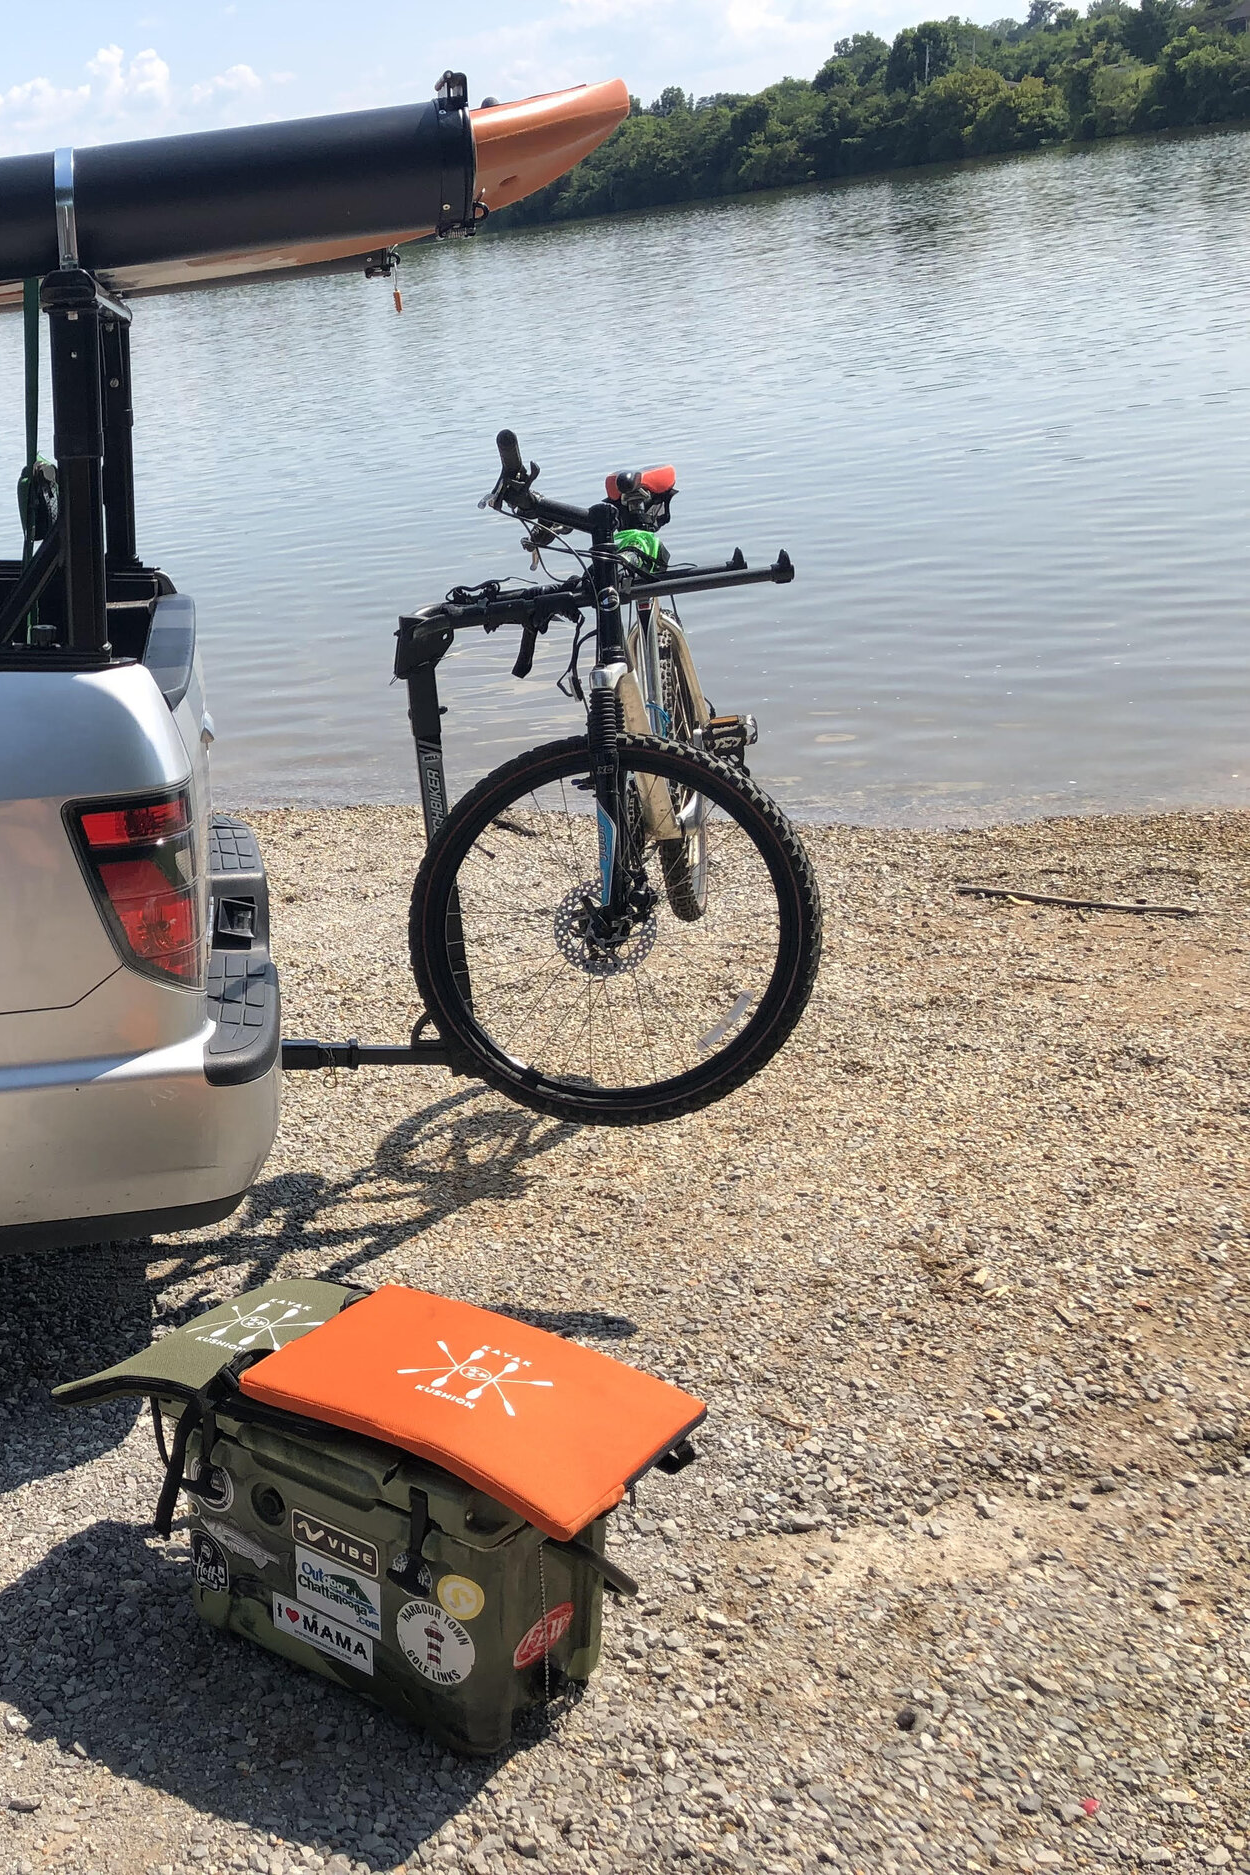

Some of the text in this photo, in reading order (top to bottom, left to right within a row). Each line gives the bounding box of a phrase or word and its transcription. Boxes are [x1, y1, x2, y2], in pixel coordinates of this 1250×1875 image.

[269, 1298, 313, 1311] KAYAK
[195, 1336, 246, 1352] KUSHION
[481, 1345, 533, 1368] KAYAK
[414, 1384, 477, 1410] KUSHION
[327, 1536, 373, 1567] VIBE
[301, 1561, 350, 1592] Outdoor
[298, 1574, 368, 1617] Chattanooga
[277, 1602, 283, 1618] I
[303, 1614, 369, 1661] MAMA
[356, 1616, 380, 1631] .com
[400, 1603, 470, 1646] HARBOUR TOWN
[407, 1649, 461, 1682] GOLF LINKS
